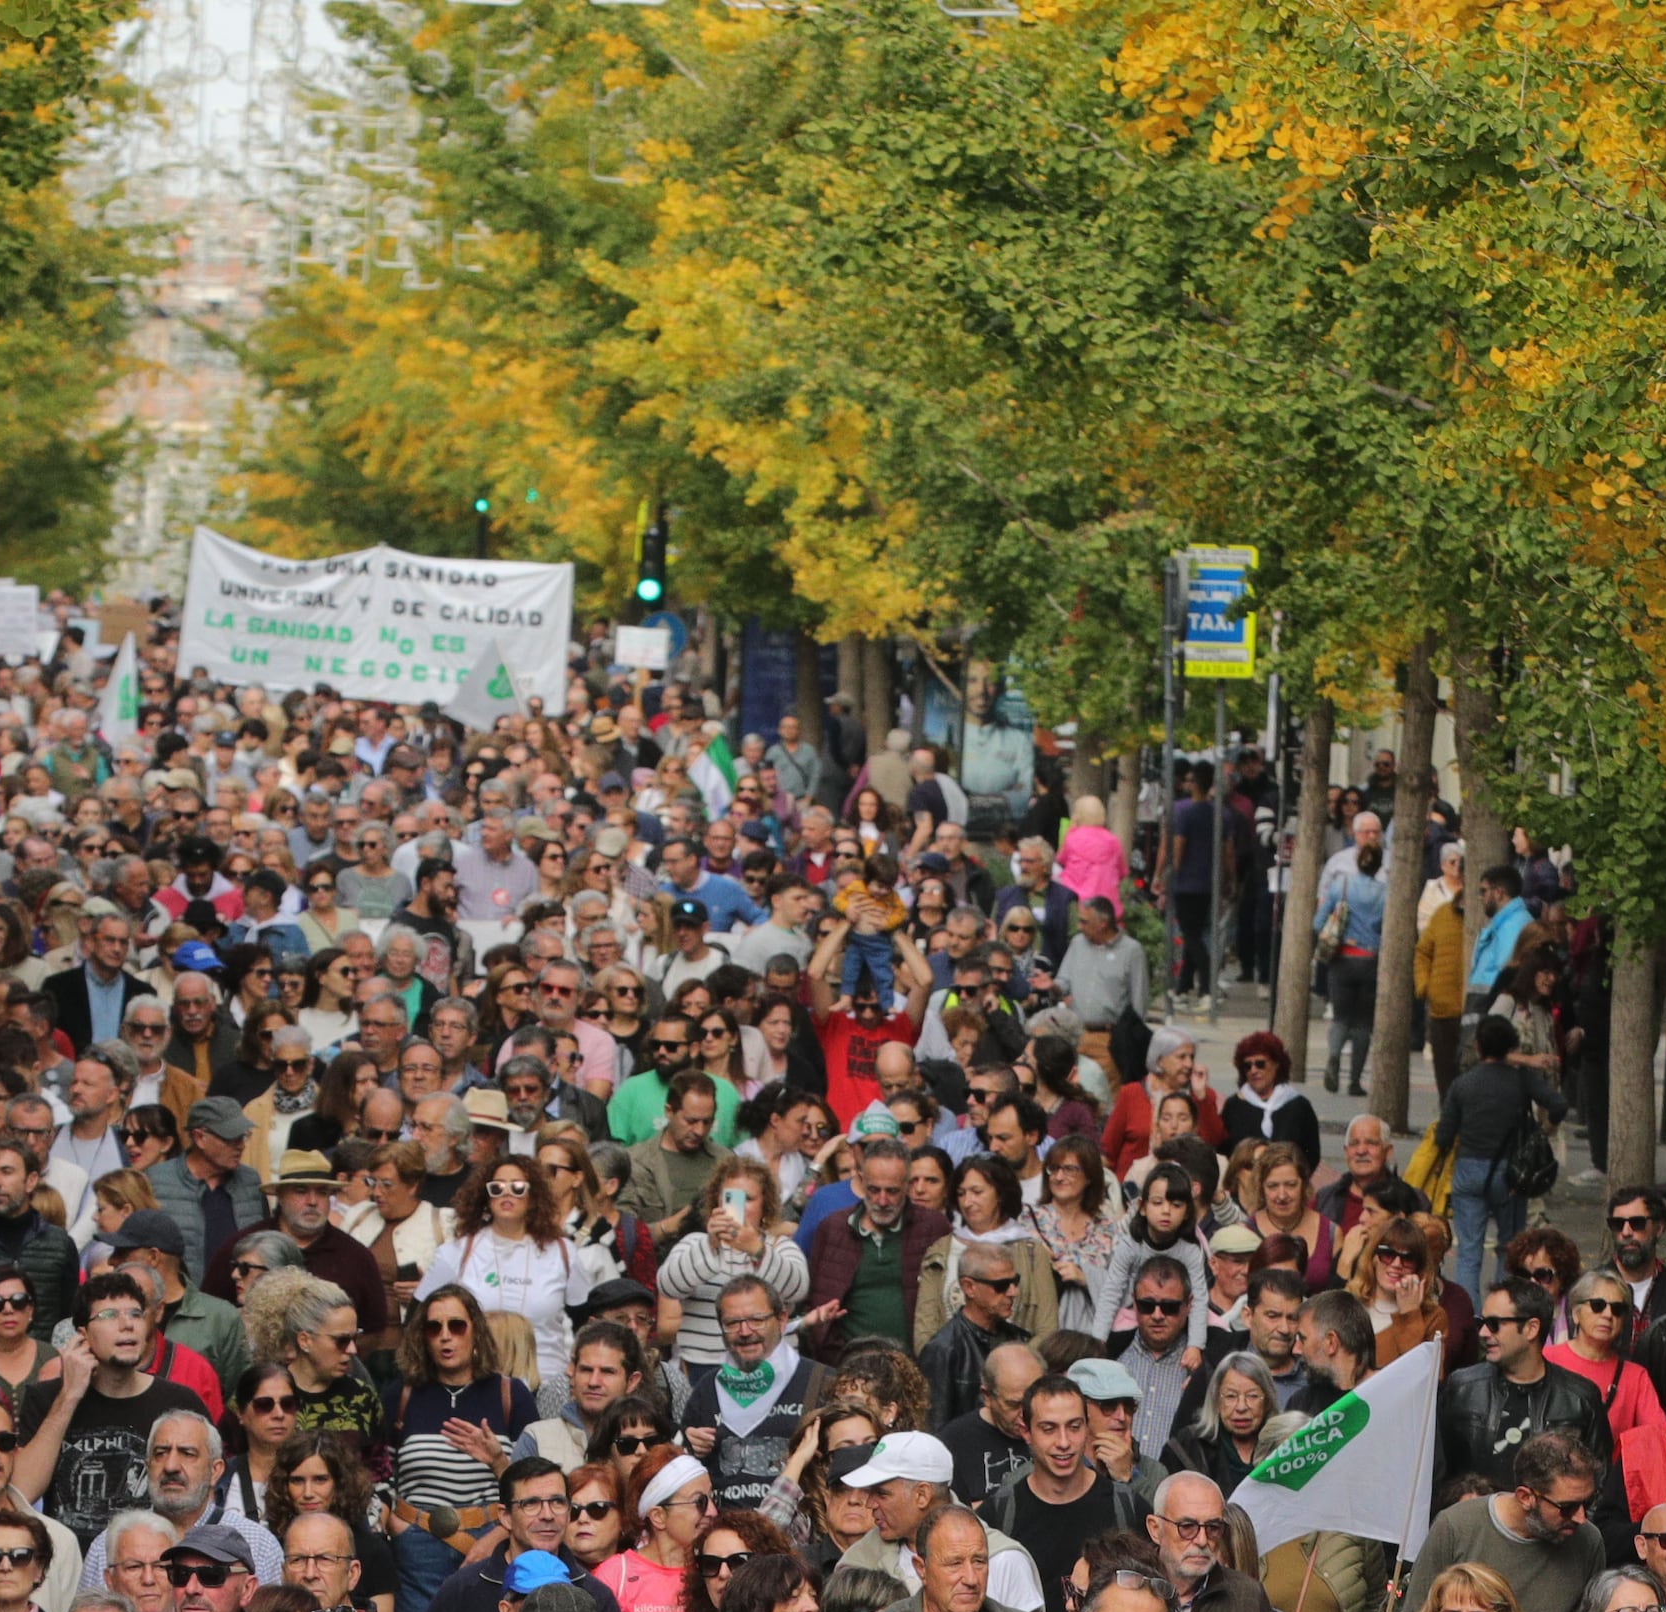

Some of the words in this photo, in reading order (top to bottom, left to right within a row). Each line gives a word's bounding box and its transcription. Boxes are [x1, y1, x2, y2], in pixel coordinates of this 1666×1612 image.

[384, 561, 498, 588] SANIDAD
[219, 580, 338, 610] UNIVERSAL
[356, 596, 374, 613] Y
[392, 599, 425, 617] DE
[440, 603, 543, 628] CALIDAD
[204, 609, 236, 630] LA
[247, 615, 353, 643] SANIDAD
[431, 633, 467, 654] ES
[231, 645, 270, 665] UN
[61, 1436, 123, 1453] DELPHI
[1266, 1450, 1328, 1479] 100%
